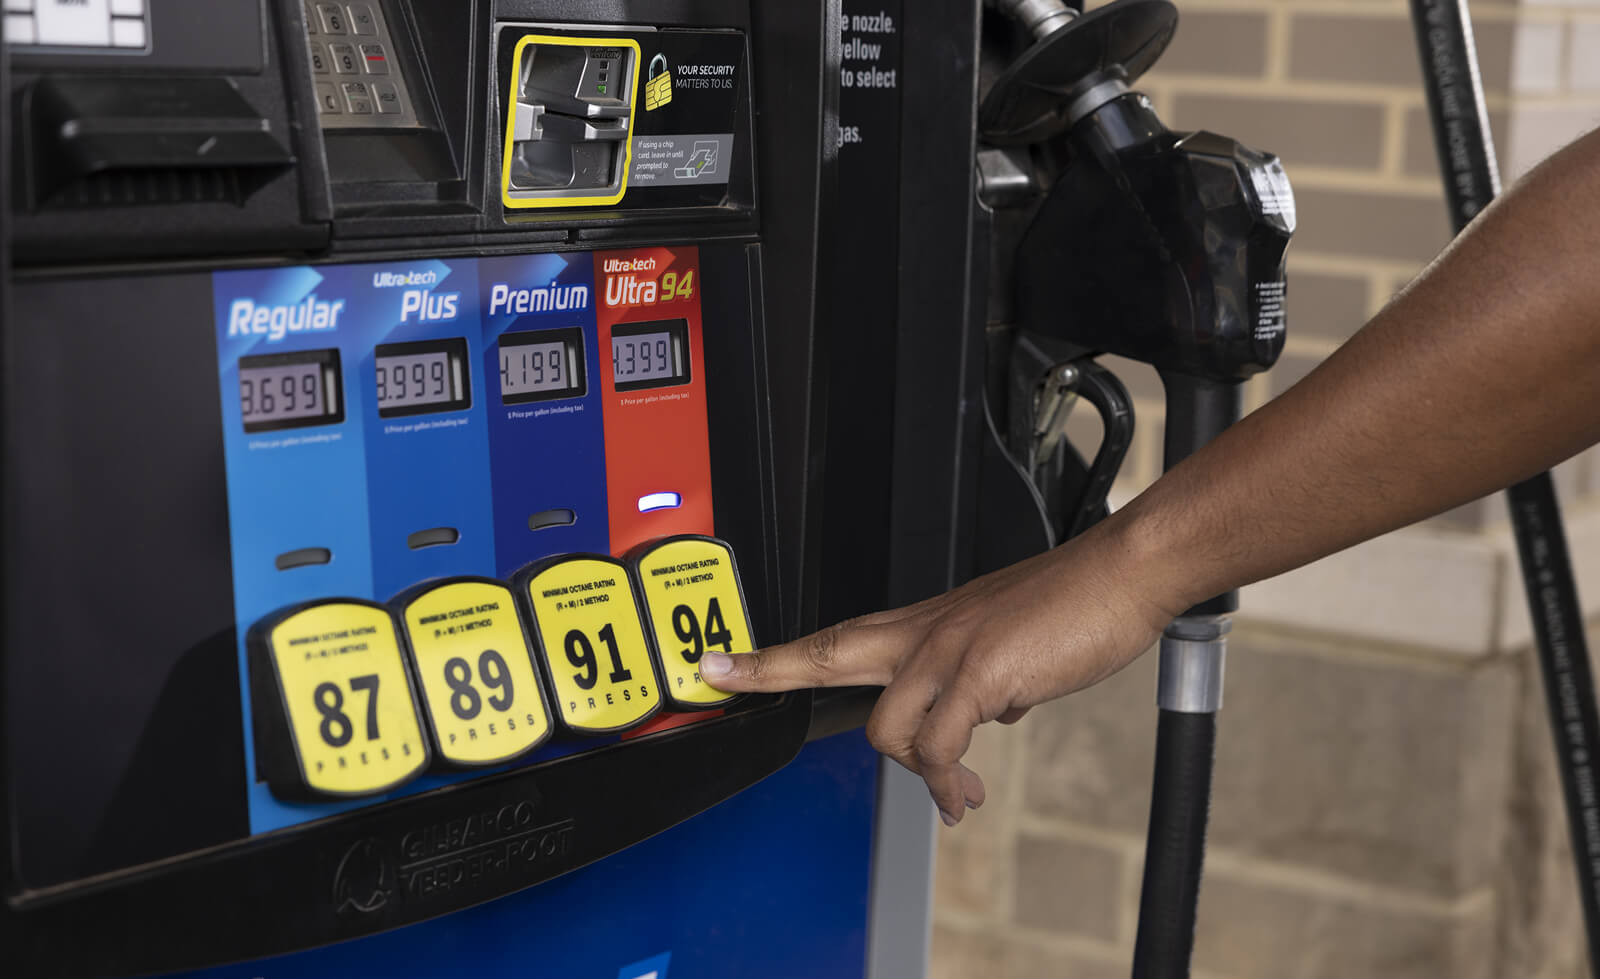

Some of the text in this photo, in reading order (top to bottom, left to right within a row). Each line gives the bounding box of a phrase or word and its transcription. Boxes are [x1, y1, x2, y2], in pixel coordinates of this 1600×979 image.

[852, 10, 896, 33] nozzle.
[677, 64, 735, 76] YOUR SECURITY
[841, 65, 897, 88] to select
[675, 78, 710, 89] MATTERS
[711, 78, 721, 89] TO
[643, 141, 658, 149] using
[662, 140, 674, 149] chip
[672, 150, 684, 158] until
[489, 281, 588, 316] Premium
[605, 270, 694, 306] Ultra 94
[400, 290, 459, 322] Plus
[228, 296, 344, 340] Regular
[651, 557, 720, 577] MINIMUM OCTANE RATING
[690, 572, 714, 583] METHOD
[542, 578, 616, 598] MINIMUM OCTANE RATING
[584, 593, 610, 605] METHOD
[448, 607, 475, 619] OCTANE
[671, 596, 733, 665] 94
[563, 622, 633, 691] 91
[443, 648, 515, 721] 89
[313, 673, 380, 748] 87
